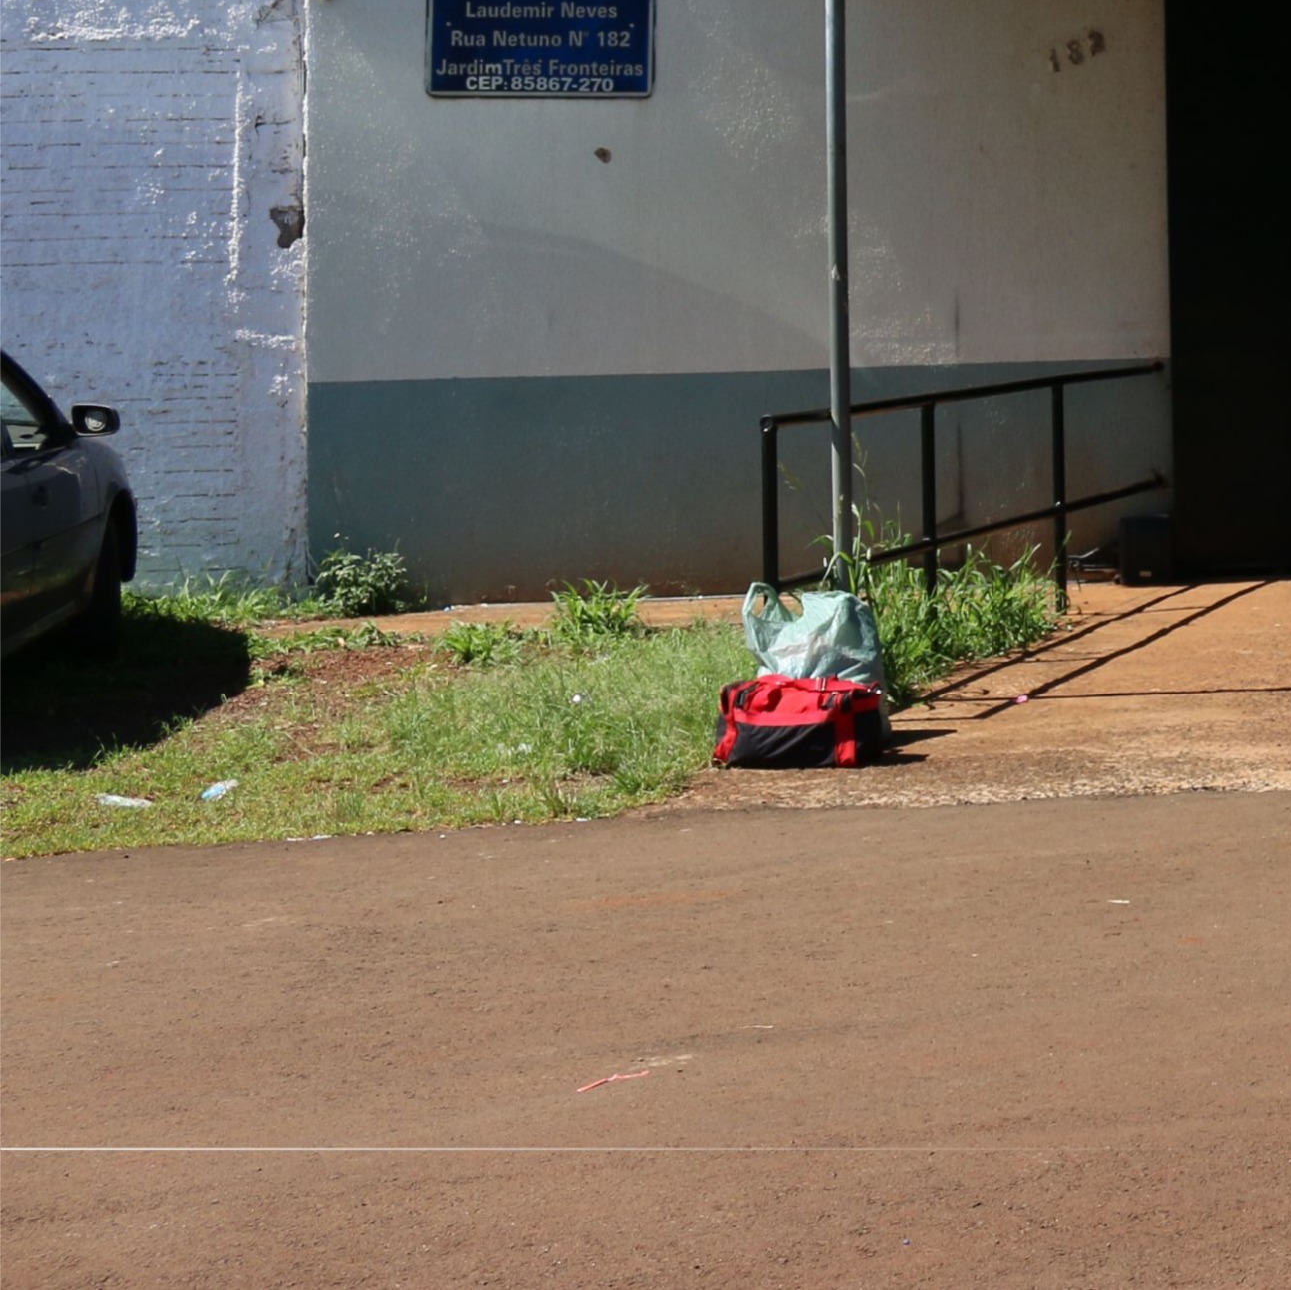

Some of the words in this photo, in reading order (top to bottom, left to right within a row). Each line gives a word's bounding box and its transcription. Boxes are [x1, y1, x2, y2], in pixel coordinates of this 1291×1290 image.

[465, 1, 554, 19] Laudemir
[561, 2, 618, 19] Neves
[451, 30, 486, 47] Rua
[493, 30, 562, 48] Netuno
[597, 31, 631, 48] 182
[549, 60, 644, 77] Fronteiras
